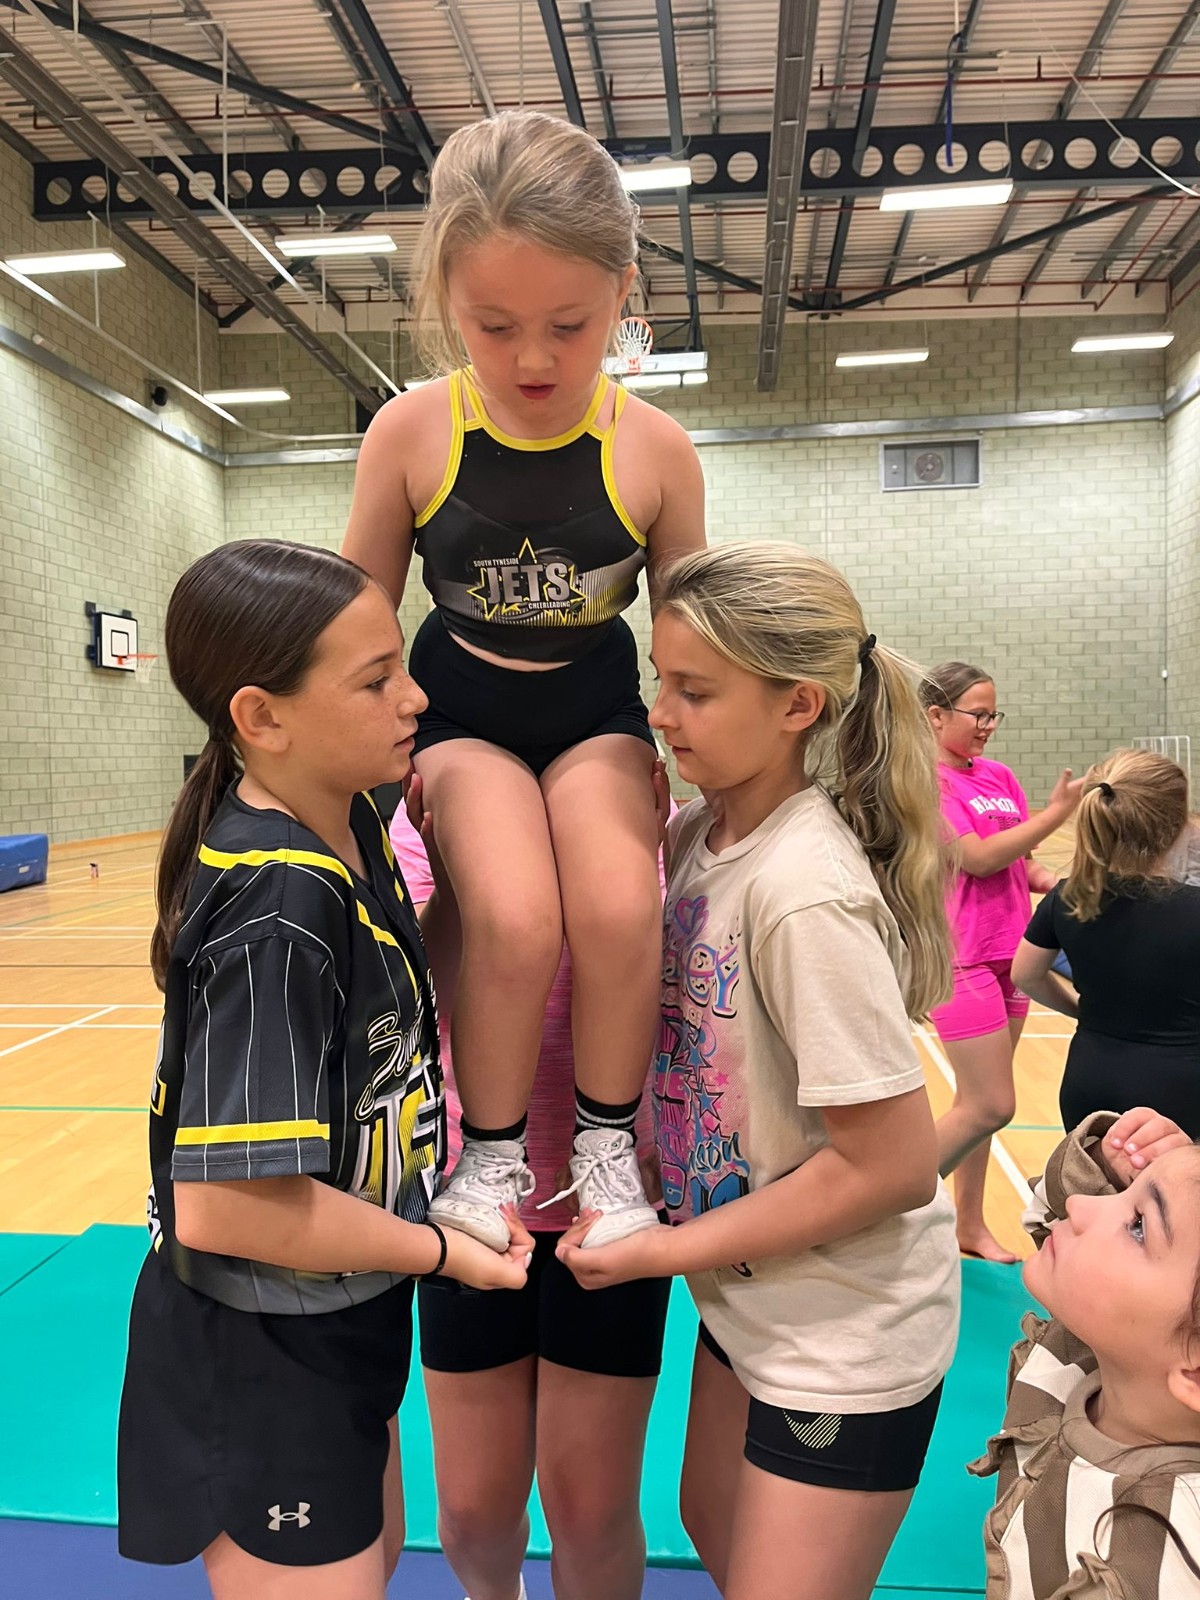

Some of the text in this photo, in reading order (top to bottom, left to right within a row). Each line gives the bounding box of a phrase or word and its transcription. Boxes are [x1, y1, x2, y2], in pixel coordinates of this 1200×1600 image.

[473, 557, 520, 567] SOUTH TYNESIDE
[485, 562, 570, 604] JETS
[528, 601, 571, 609] CHEERLEADING
